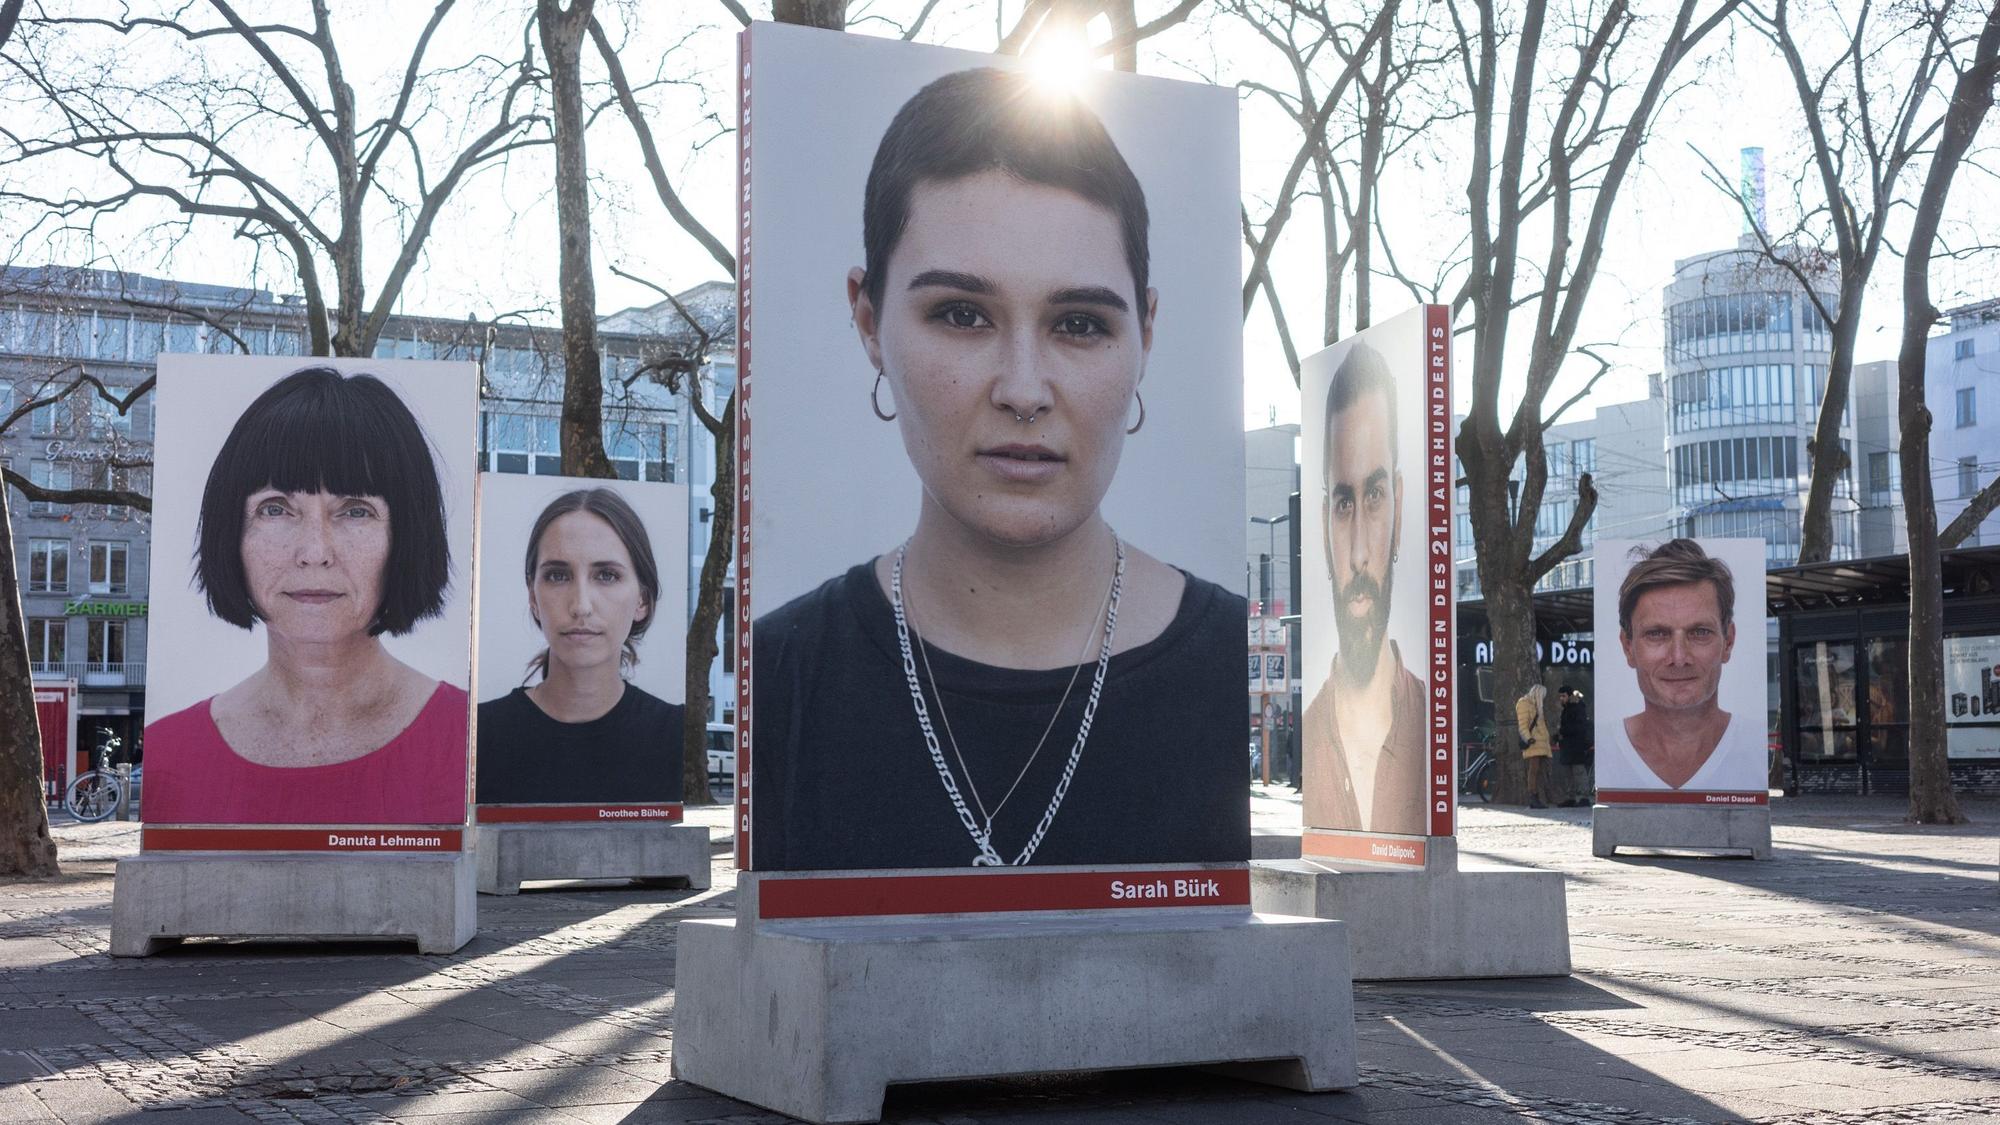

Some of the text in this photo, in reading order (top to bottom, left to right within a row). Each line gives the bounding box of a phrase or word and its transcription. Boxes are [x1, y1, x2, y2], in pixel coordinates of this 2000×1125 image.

[743, 61, 751, 351] JAHRHUNDERTS
[742, 363, 752, 421] 21.
[1431, 326, 1448, 813] DIE DEUTSCHEN DES 21. JAHRHUNDERTS
[742, 524, 750, 748] DEUTSCHEN
[1551, 640, 1595, 664] Dön
[1706, 795, 1756, 803] Daniel Dassel
[599, 808, 669, 818] Dorothee Bühler
[328, 834, 441, 847] Danuta Lehmann
[1371, 843, 1388, 857] David
[1110, 879, 1220, 899] Sarah Bürk
